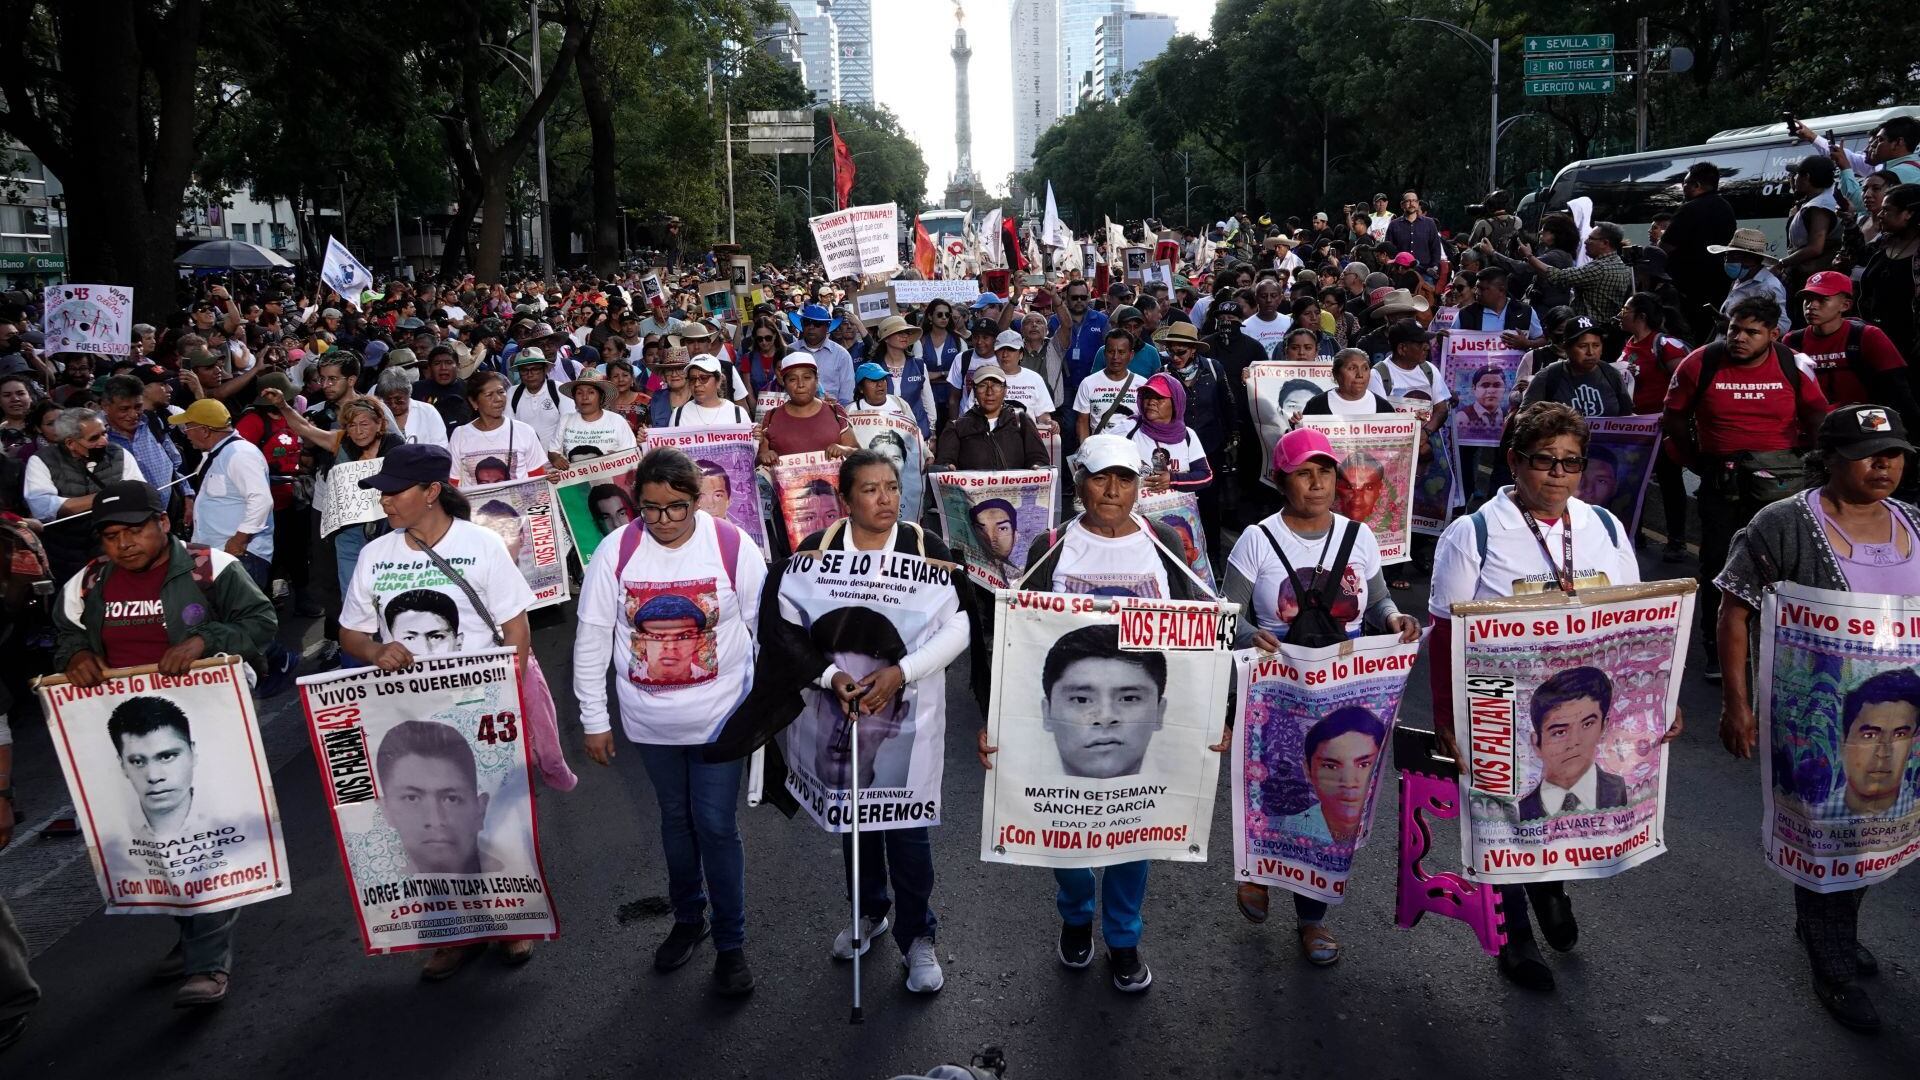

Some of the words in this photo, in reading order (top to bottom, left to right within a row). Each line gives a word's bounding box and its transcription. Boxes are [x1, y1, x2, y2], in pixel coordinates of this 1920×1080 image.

[1546, 39, 1589, 48] SEVILLA
[1601, 37, 1607, 46] 3
[1533, 63, 1539, 71] 2
[1548, 61, 1564, 71] RIO
[1568, 60, 1595, 70] TIBER
[1533, 82, 1575, 92] EJERCITO
[1578, 82, 1597, 91] NAL
[1762, 184, 1783, 196] 01
[74, 287, 89, 300] 43
[109, 287, 130, 306] VIVOS
[102, 342, 130, 355] ESTADO
[1284, 369, 1295, 378] se
[1297, 367, 1307, 377] lo
[1715, 382, 1783, 391] MARABUNTA
[1733, 392, 1766, 400] B.H.P.
[1333, 427, 1346, 436] se
[1350, 425, 1360, 435] lo
[1363, 422, 1415, 435] llevaron!
[1603, 420, 1659, 433] llevaron!
[649, 436, 676, 449] ¡Vivo
[679, 437, 692, 445] se
[694, 433, 704, 443] lo
[708, 431, 753, 443] llevaron!
[578, 467, 589, 476] se
[589, 463, 599, 474] lo
[600, 452, 641, 471] llevaron!
[788, 458, 801, 466] se
[805, 455, 816, 464] lo
[939, 474, 967, 487] ¡Vivo
[971, 478, 984, 487] se
[987, 476, 998, 486] lo
[1001, 473, 1051, 485] llevaron!
[531, 515, 553, 548] FALTAN
[397, 563, 410, 571] se
[412, 560, 424, 571] lo
[536, 547, 556, 566] NOS
[819, 553, 844, 574] SE
[850, 554, 871, 576] LO
[880, 554, 957, 586] LLEVARO
[977, 566, 986, 579] lo
[1525, 573, 1547, 583] JORGE
[1581, 568, 1597, 578] NAVA
[815, 576, 847, 588] Alumno
[850, 578, 907, 593] desaparecido
[909, 585, 917, 595] de
[829, 588, 880, 602] Ayotzinapa,
[883, 593, 902, 605] Gro.
[1009, 592, 1065, 614] ¡Vivo
[1072, 597, 1093, 614] se
[1469, 618, 1526, 643] ¡Vivo
[1533, 620, 1560, 637] se
[1567, 614, 1586, 634] lo
[1591, 601, 1678, 630] llevaron!
[1781, 602, 1839, 632] ¡Vivo
[1848, 618, 1876, 636] se
[1120, 611, 1154, 647] NOS
[1158, 612, 1217, 648] FALTAN
[1216, 613, 1238, 650] 43
[1252, 659, 1299, 683] ¡Vivo
[1305, 669, 1327, 685] se
[1332, 661, 1348, 681] lo
[1353, 653, 1417, 676] llevaro
[108, 681, 125, 696] se
[129, 675, 145, 693] lo
[149, 667, 230, 691] llevaron!
[318, 685, 367, 707] VIVOS
[376, 681, 405, 697] LOS
[409, 667, 508, 695] QUEREMOS!!!
[1467, 674, 1515, 698] 43!
[1332, 689, 1357, 699] Escocia,
[478, 711, 518, 745] 43
[1472, 697, 1511, 757] FALTAN
[1473, 757, 1512, 794] NOS
[335, 775, 375, 804] NOS
[1025, 786, 1080, 800] MARTÍN
[1083, 785, 1167, 801] GETSEMANY
[827, 801, 936, 827] QUEREMOS
[1033, 802, 1103, 816] SÁNCHEZ
[1106, 799, 1156, 814] GARCÍA
[1052, 820, 1087, 829] EDAD
[1091, 821, 1106, 829] 20
[1109, 816, 1142, 828] AÑOS
[1512, 826, 1549, 838] JORGE
[1554, 816, 1605, 832] ÁLVAREZ
[1613, 810, 1636, 826] NAVA
[1778, 812, 1823, 839] EMILIANO
[1829, 829, 1857, 839] ALEN
[1861, 826, 1897, 837] GASPAR
[132, 826, 236, 849] MAGDALENO
[176, 834, 246, 857] LAURO
[1000, 824, 1035, 846] ¡Con
[1042, 829, 1082, 849] VIDA
[1087, 831, 1102, 849] lo
[1106, 824, 1188, 850] queremos!
[1808, 840, 1832, 850] Celso
[1253, 840, 1310, 857] GIOVANNI
[1484, 849, 1535, 872] ¡Vivo
[1542, 848, 1558, 866] lo
[1564, 824, 1650, 867] queremos!
[145, 850, 225, 870] VILLEGAS
[171, 867, 186, 878] 19
[188, 859, 228, 874] AÑOS
[1779, 845, 1826, 879] ¡Vivo
[1831, 859, 1849, 877] lo
[117, 879, 144, 897] ¡Con
[146, 877, 171, 896] VIDA
[185, 861, 268, 899] queremos!
[1257, 858, 1304, 882] ¡Vivo
[1310, 869, 1327, 890] lo
[363, 882, 401, 907] JORGE
[403, 877, 450, 899] ANTONIO
[450, 877, 488, 896] TIZAPA
[491, 874, 543, 895] LEGIDEÑO
[390, 899, 458, 920] ¿DÓNDE
[463, 896, 526, 911] ESTÁN?
[372, 922, 402, 934] CONTRA
[402, 921, 413, 931] EL
[412, 916, 454, 930] TERRORISMO
[456, 916, 467, 926] DE
[495, 913, 505, 922] LA
[417, 928, 460, 940] AYOTZINAPA
[461, 926, 484, 935] SOMOS
[485, 922, 509, 932] TODOS
